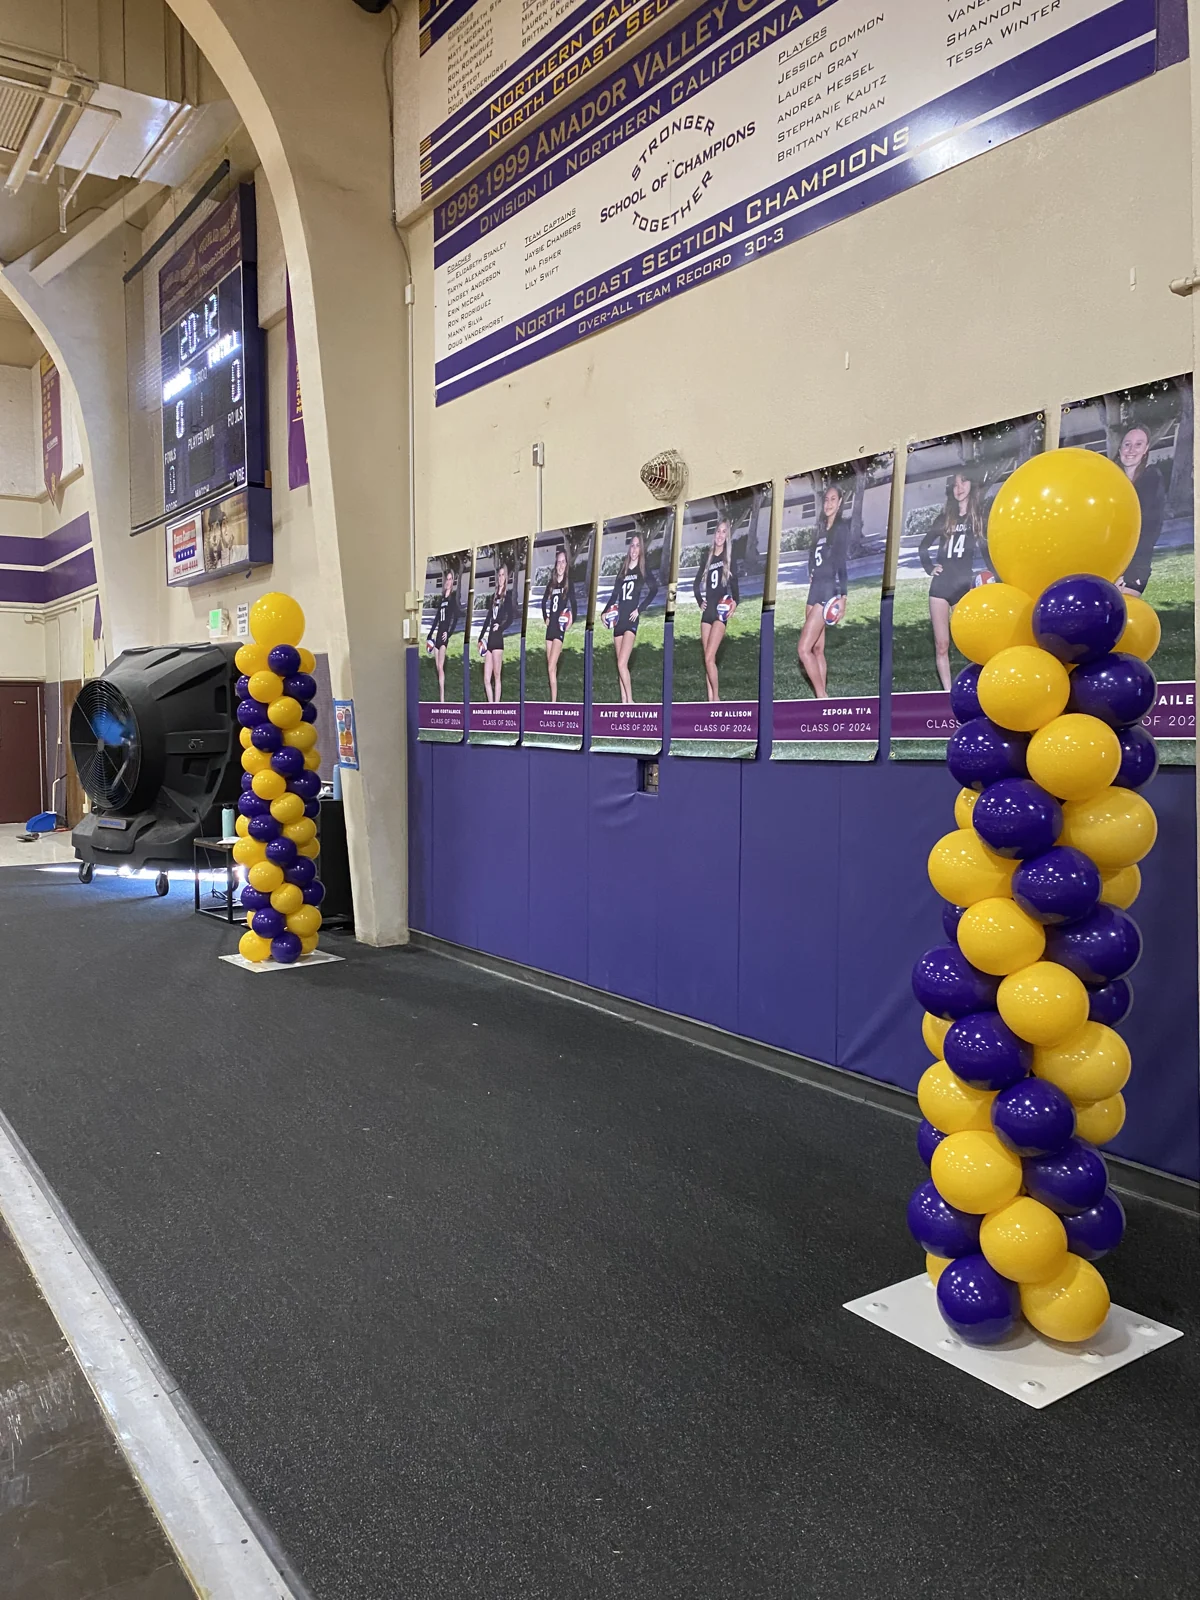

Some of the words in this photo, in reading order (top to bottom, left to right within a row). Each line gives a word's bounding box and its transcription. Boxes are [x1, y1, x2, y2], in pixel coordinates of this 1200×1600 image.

[457, 11, 487, 42] ELIZABETH
[522, 10, 533, 24] MIA
[522, 9, 547, 35] LAUREN
[946, 0, 1021, 47] SHANNON
[948, 0, 993, 23] VANE
[522, 16, 552, 47] BRITTANY
[778, 26, 827, 63] PLAYERS
[946, 38, 993, 67] TESSA
[1000, 0, 1060, 38] WINTER
[448, 45, 462, 62] MATT
[448, 69, 459, 83] RON
[461, 37, 493, 69] RODRIGUEZ
[448, 50, 468, 72] PHILLIP
[777, 51, 824, 85] JESSICA
[829, 13, 884, 53] COMMON
[448, 69, 473, 94] NATASHA
[465, 60, 507, 99] VANDERHORST
[489, 92, 544, 146] NORTH
[553, 32, 616, 95] COAST
[490, 33, 583, 120] NORTHERN
[778, 72, 821, 104] LAUREN
[827, 49, 859, 75] GRAY
[448, 90, 460, 104] LYLE
[777, 93, 821, 124] ANDREA
[827, 62, 875, 95] HESSEL
[440, 144, 529, 230] 1998-1999
[535, 78, 627, 161] AMADOR
[632, 0, 732, 89] VALLEY
[480, 184, 536, 234] DIVISION
[566, 100, 660, 175] NORTHERN
[671, 5, 803, 104] CALIFORNIA
[777, 101, 841, 143] STEPHANIE
[846, 74, 887, 104] KAUTZ
[778, 127, 830, 162] BRITTANY
[835, 96, 885, 131] KERNAN
[631, 115, 715, 181] STRONGER
[600, 188, 646, 223] SCHOOL
[652, 173, 668, 193] OF
[674, 121, 756, 179] CHAMPIONS
[632, 170, 713, 233] TOGETHER
[515, 302, 566, 341] NORTH
[574, 268, 633, 310] COAST
[642, 216, 733, 276] SECTION
[746, 126, 909, 224] CHAMPIONS
[524, 231, 541, 246] TEAM
[543, 208, 577, 233] CAPTAINS
[524, 245, 545, 262] JAYSIE
[546, 222, 581, 248] CHAMBERS
[447, 253, 472, 274] COACHES
[455, 258, 482, 279] ELIZABETH
[483, 241, 507, 260] STANLEY
[524, 264, 537, 275] MIA
[538, 249, 561, 268] FISHER
[447, 281, 463, 295] TARYN
[464, 260, 496, 285] ALEXANDER
[447, 289, 469, 306] LINDSEY
[471, 270, 501, 293] ANDERSON
[524, 278, 538, 290] LILY
[539, 265, 560, 282] SWIFT
[578, 301, 633, 335] OVER-ALL
[637, 283, 671, 306] TEAM
[676, 253, 732, 288] RECORD
[744, 227, 784, 257] 30-3
[447, 305, 460, 317] ERIN
[447, 317, 459, 329] RON
[460, 299, 491, 320] RODRIGUEZ
[447, 326, 466, 339] MANNY
[467, 316, 483, 329] SILVA
[447, 338, 463, 351] DOUG
[464, 316, 504, 341] VANDERHORST
[814, 546, 823, 567] 5
[947, 534, 966, 558] 14
[621, 581, 635, 600] 12
[711, 570, 719, 589] 9
[552, 595, 558, 612] 8
[600, 711, 618, 719] KATIE
[619, 711, 658, 719] O'SULLIVAN
[822, 707, 853, 716] ZEPORA
[855, 707, 872, 715] TI'A
[1154, 694, 1194, 706] AILE
[539, 720, 556, 728] CLASS
[566, 721, 579, 729] 2024
[610, 723, 630, 731] CLASS
[642, 724, 658, 732] 2024
[694, 724, 717, 732] CLASS
[720, 724, 731, 732] OF
[733, 724, 751, 732] 2024
[800, 723, 829, 732] CLASS
[832, 723, 845, 732] OF
[848, 723, 871, 732] 2024
[926, 719, 962, 729] CLASS
[1141, 715, 1162, 726] OF
